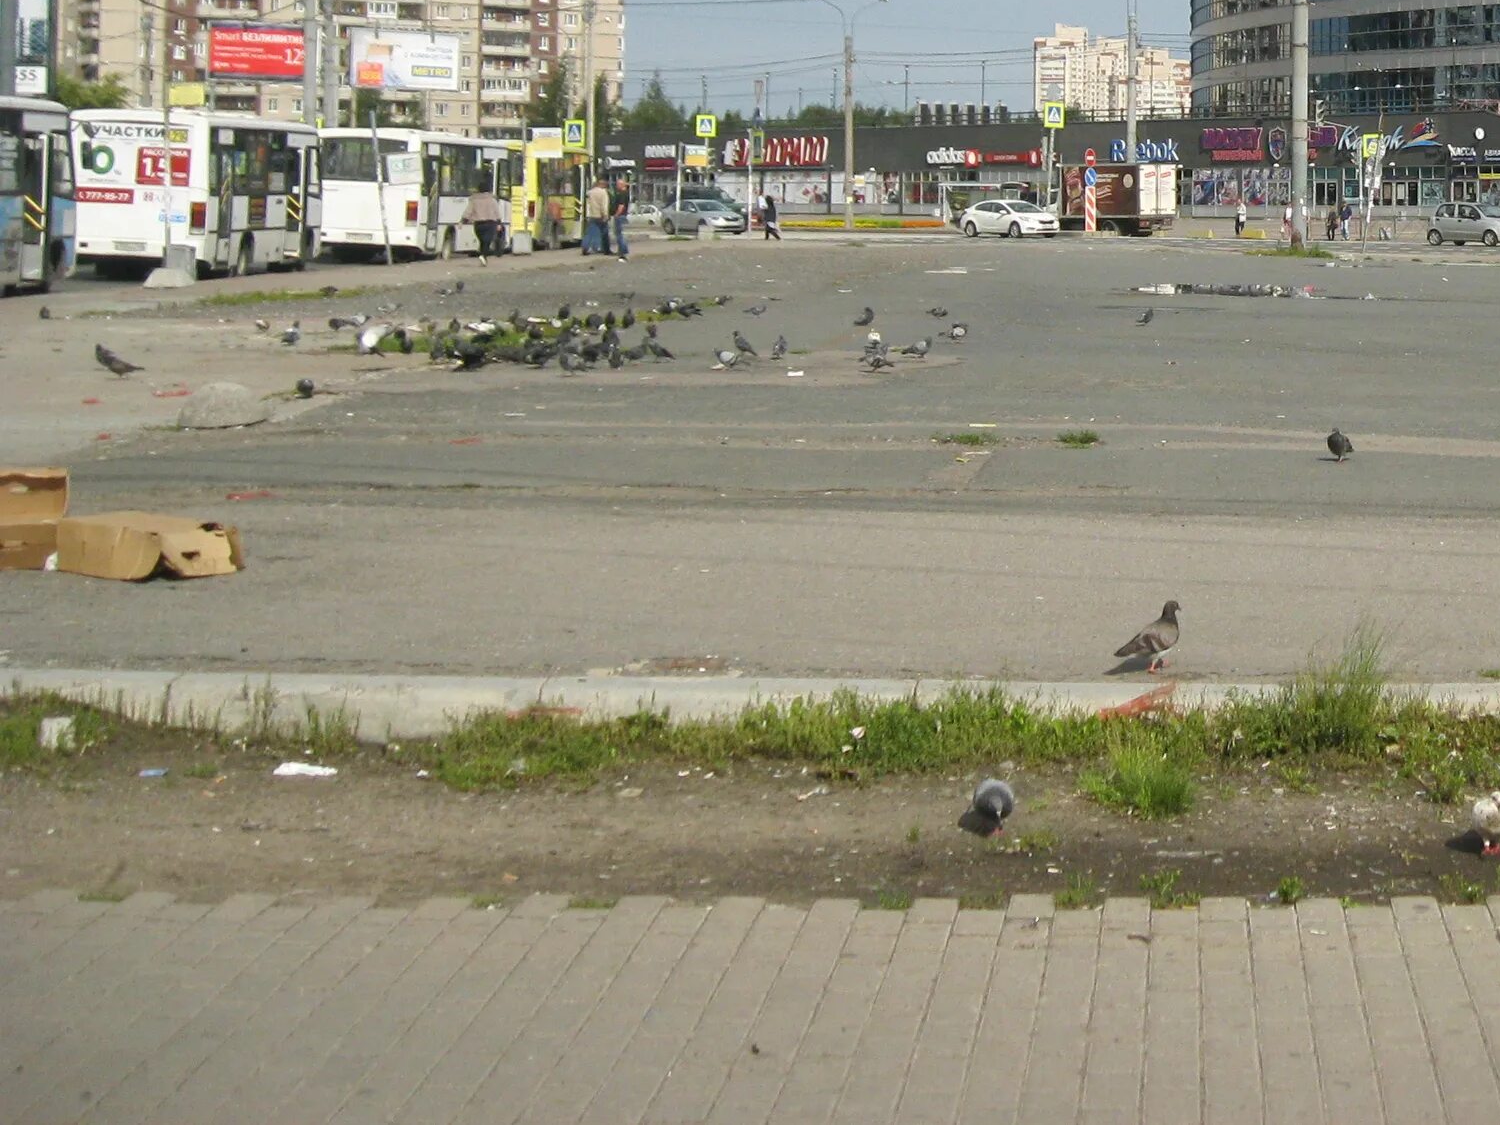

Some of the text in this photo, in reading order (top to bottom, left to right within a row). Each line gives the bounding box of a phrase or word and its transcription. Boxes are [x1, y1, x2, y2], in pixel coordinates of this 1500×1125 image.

[412, 66, 450, 77] METRO
[91, 125, 166, 138] УЧАСТКИ
[926, 146, 966, 164] adidas
[1109, 138, 1180, 163] Rebok
